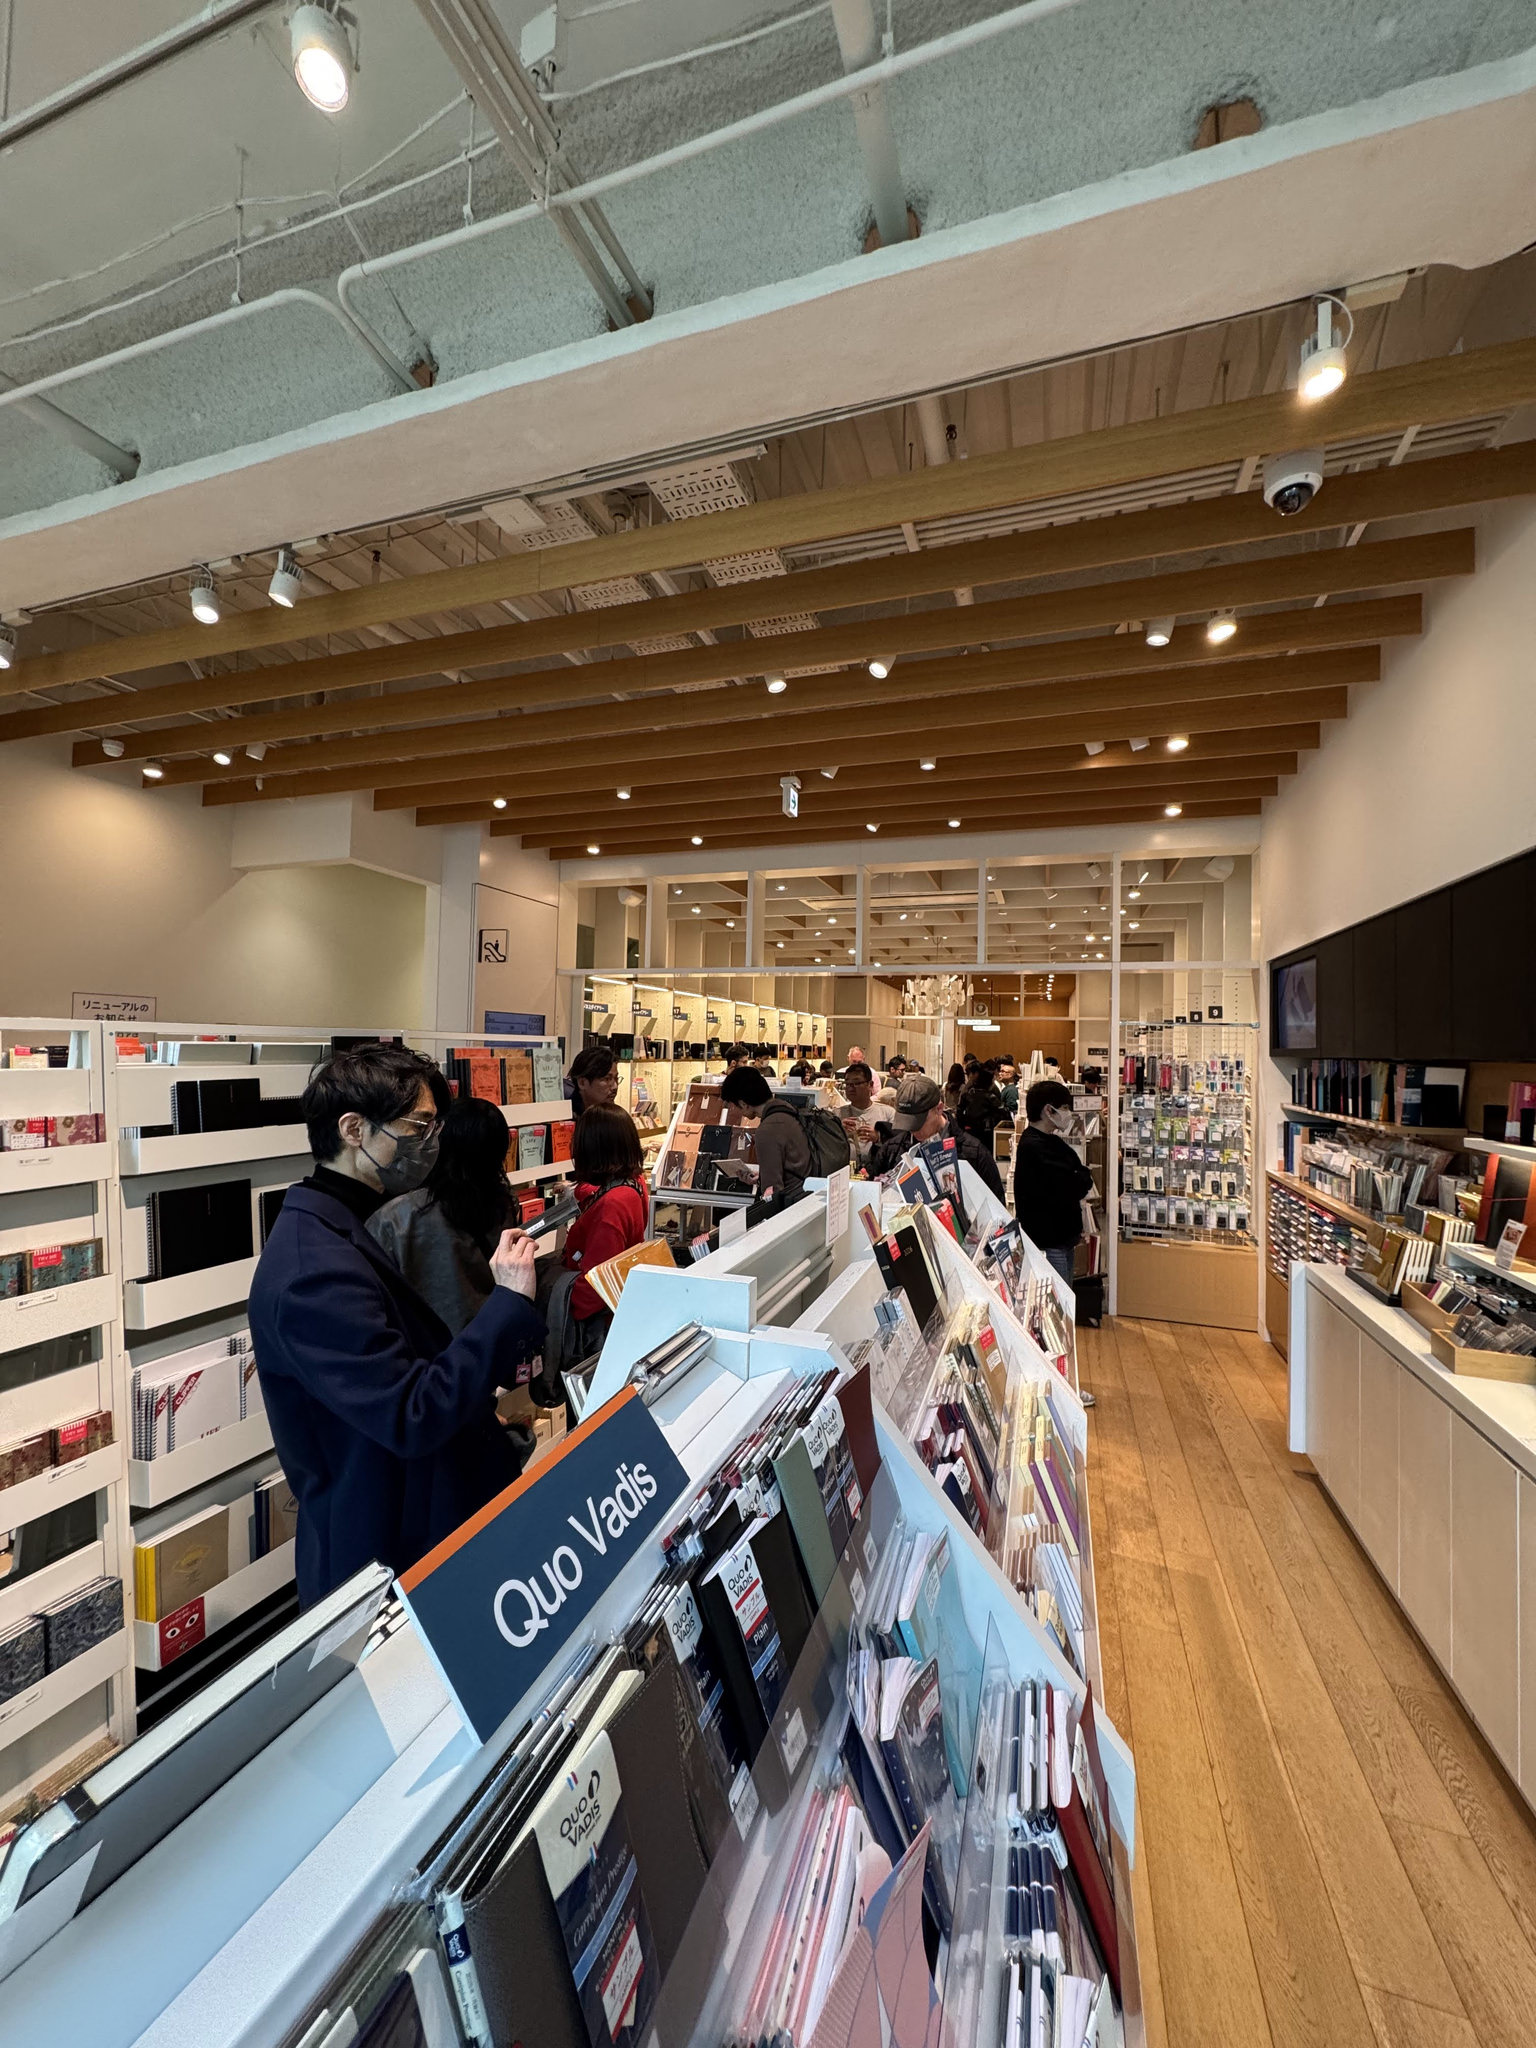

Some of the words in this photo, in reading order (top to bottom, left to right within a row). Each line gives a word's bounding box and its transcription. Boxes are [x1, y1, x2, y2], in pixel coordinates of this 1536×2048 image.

[82, 1000, 149, 1012] リニューアルの
[175, 1375, 197, 1405] CLIPPER
[493, 1545, 583, 1648] Quo
[567, 1462, 658, 1556] Vadis
[727, 1569, 745, 1591] QUO
[733, 1573, 754, 1598] VADIS
[741, 1592, 760, 1617] サンプル
[672, 1612, 687, 1636] QUO
[677, 1615, 696, 1644] VADIS
[753, 1622, 769, 1646] Plain
[560, 1796, 588, 1838] QUO
[567, 1799, 600, 1848] VADIS
